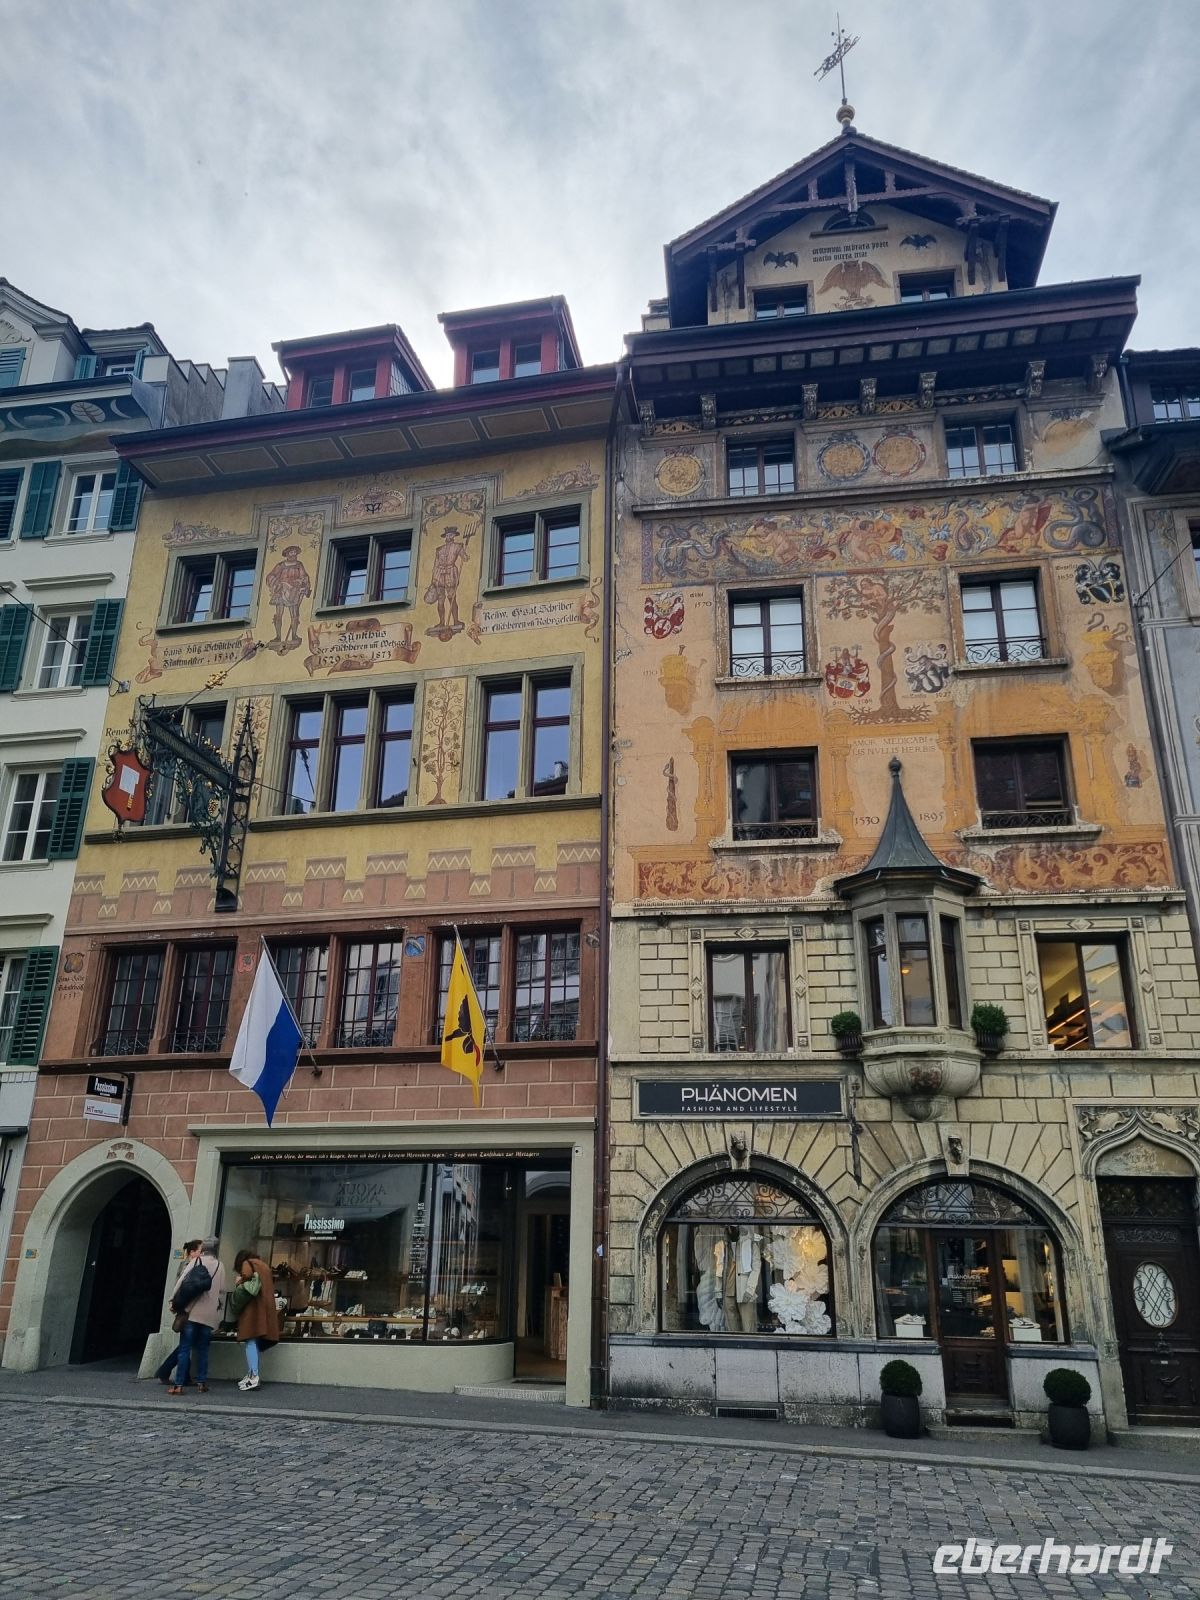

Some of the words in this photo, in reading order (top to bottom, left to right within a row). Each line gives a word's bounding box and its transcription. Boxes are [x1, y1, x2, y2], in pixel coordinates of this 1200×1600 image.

[371, 650, 392, 661] 1873
[855, 816, 880, 825] 1530
[919, 811, 945, 822] 1895
[681, 1084, 798, 1102] PHÄNOMEN
